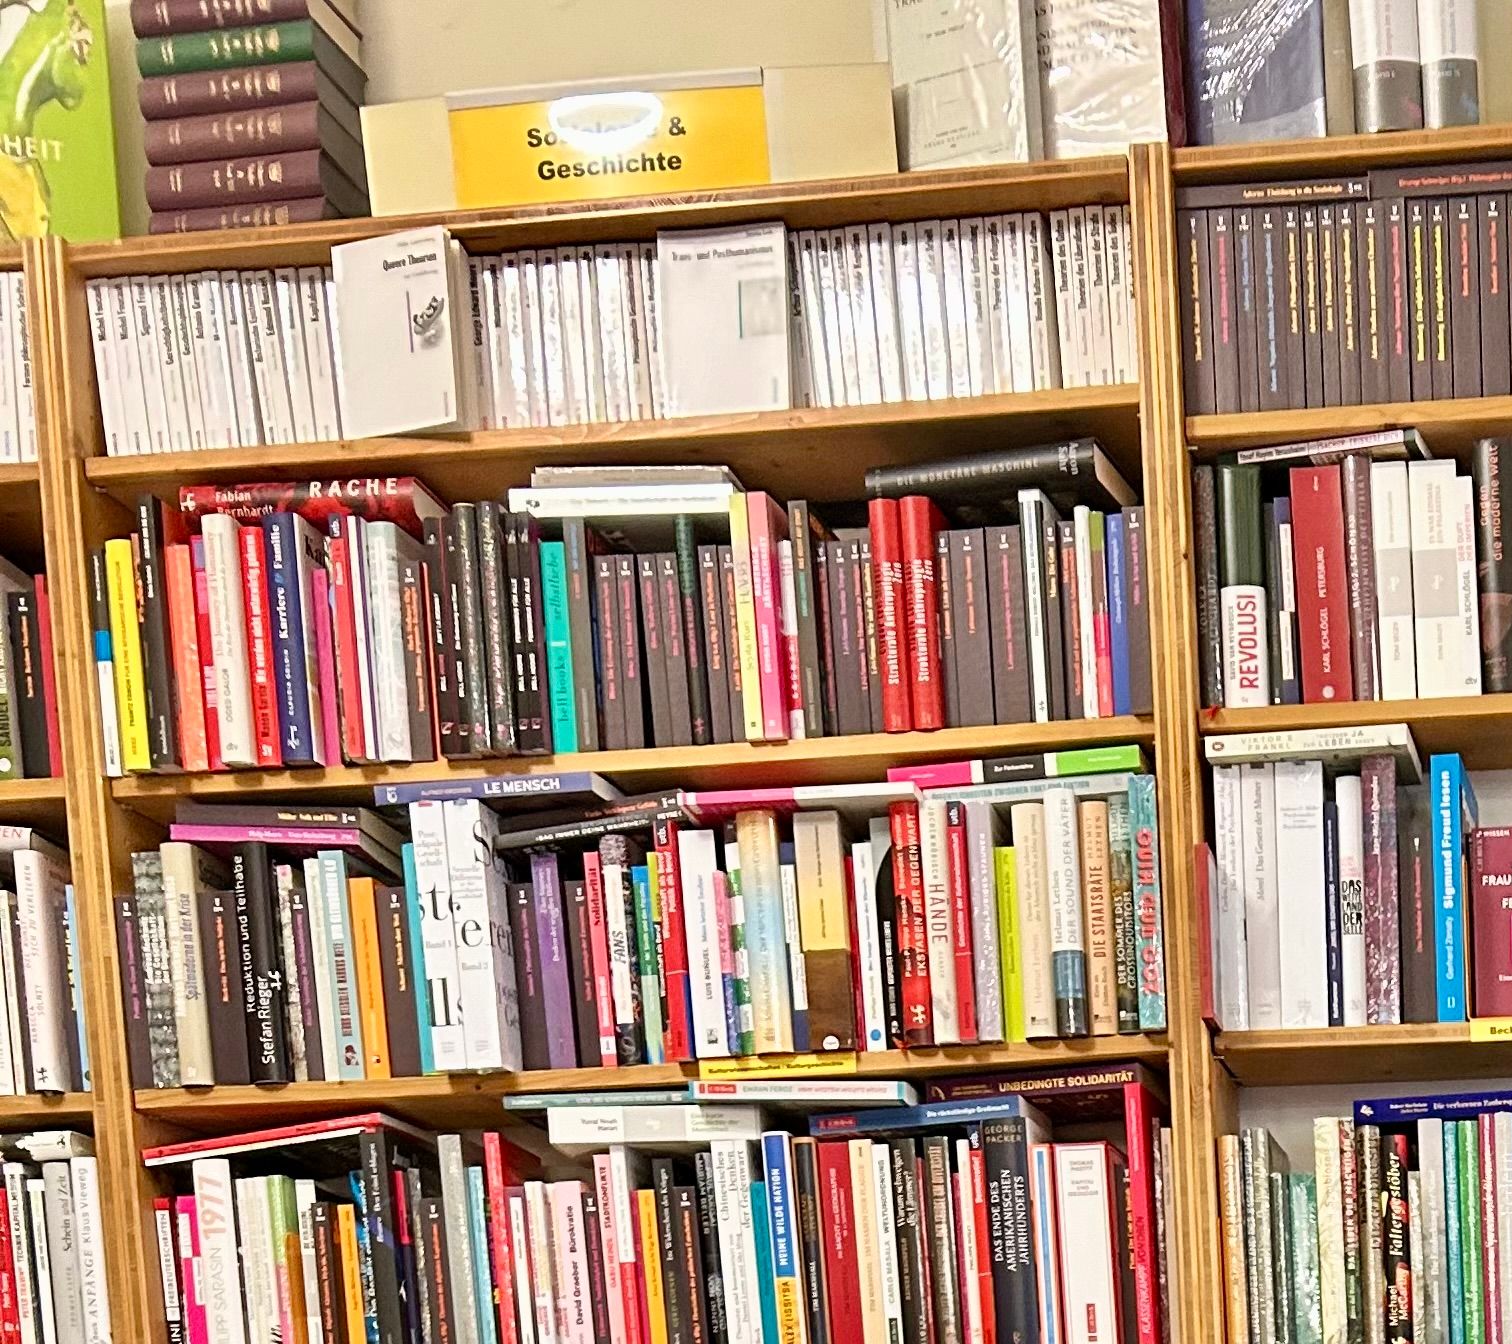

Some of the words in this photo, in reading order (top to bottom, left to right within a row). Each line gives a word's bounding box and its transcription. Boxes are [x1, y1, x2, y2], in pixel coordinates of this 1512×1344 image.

[669, 117, 686, 136] &
[538, 152, 682, 180] Geschichte
[215, 491, 251, 503] Fabian
[309, 478, 398, 497] RACHE
[278, 586, 287, 639] Karriere
[1236, 595, 1259, 689] REVOLUSI
[502, 778, 560, 792] MENSCH
[1440, 810, 1451, 848] Freud
[1441, 850, 1456, 909] Sigmund
[929, 883, 948, 944] HÄNDE
[613, 930, 625, 965] FANS
[1093, 941, 1104, 958] DIE
[257, 976, 272, 1020] Rieger
[261, 1021, 276, 1064] Stefan
[999, 1078, 1065, 1092] UNBEDINGTE
[1067, 1070, 1133, 1088] SOLIDARITÄT
[198, 1175, 226, 1240] 1977
[989, 1181, 999, 1205] DES
[1385, 1152, 1404, 1257] Faltergestöber
[992, 1208, 1002, 1242] ENDE
[1001, 1169, 1018, 1272] AMERIKANISCHEN
[1015, 1175, 1030, 1265] JAHRHUNDERTS
[994, 1244, 1004, 1262] DAS
